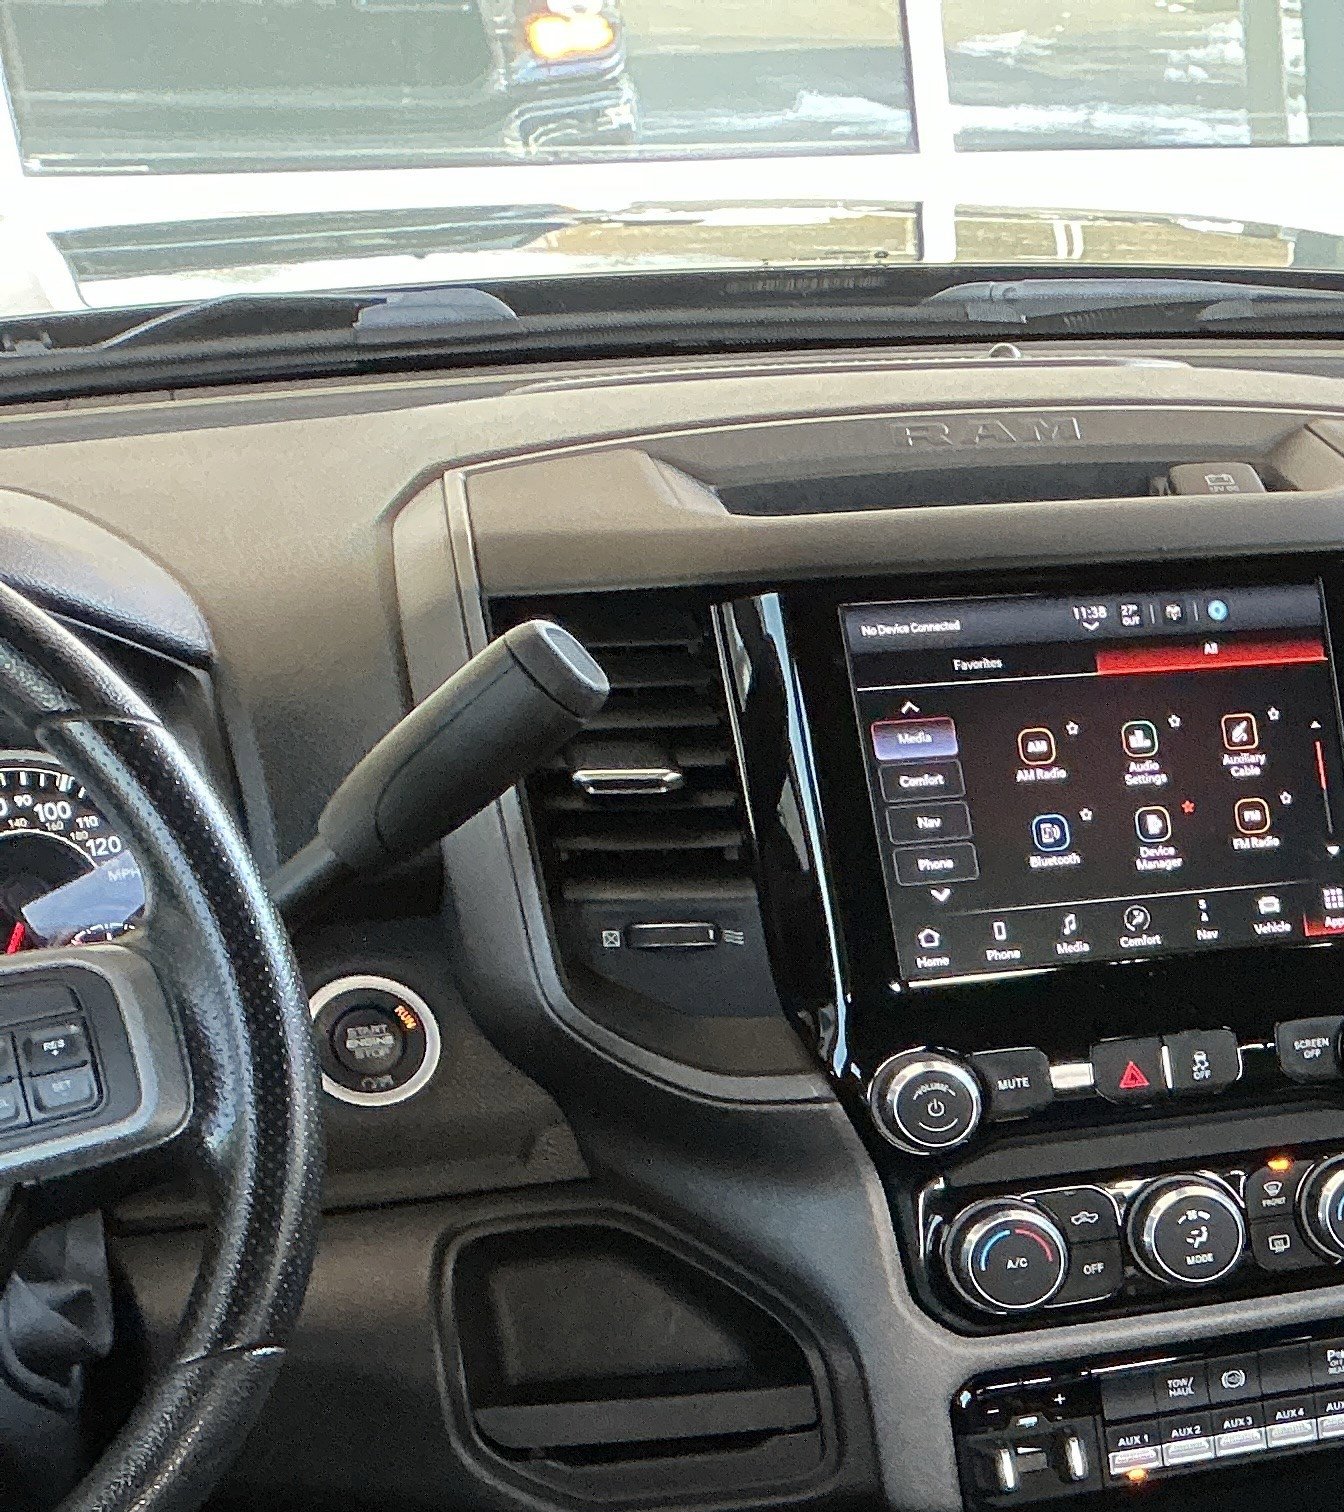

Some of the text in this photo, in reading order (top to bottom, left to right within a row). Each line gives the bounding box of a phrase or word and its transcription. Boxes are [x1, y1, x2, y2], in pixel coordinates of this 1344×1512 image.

[892, 416, 1081, 447] RAM
[1072, 605, 1107, 619] 11:38
[861, 619, 961, 636] No Device Connected
[953, 657, 1003, 671] Favorites
[897, 732, 932, 744] Media
[1223, 752, 1266, 766] Auxiliary
[1128, 761, 1160, 773] Audio
[1230, 765, 1261, 778] Cable
[899, 774, 945, 787] Comfort
[1016, 767, 1067, 782] AM Radio
[1124, 773, 1168, 787] Settings
[14, 794, 33, 808] 90
[33, 801, 72, 823] 100
[8, 817, 28, 829] 140
[76, 816, 99, 829] 110
[917, 816, 942, 829] Nav
[86, 836, 122, 857] 120
[1232, 836, 1281, 850] FM Radio
[1140, 846, 1176, 858] Device
[917, 858, 954, 871] Phone
[1029, 853, 1081, 868] Bluetooth
[1136, 857, 1183, 871] Manager
[1196, 929, 1219, 941] Nav
[1253, 922, 1292, 935] Vehicle
[1056, 941, 1090, 954] Media
[1119, 935, 1162, 948] Comfort
[986, 949, 1021, 961] Phone
[916, 956, 950, 969] Home
[394, 1005, 416, 1029] RUN
[1294, 1038, 1329, 1050] SCREEN
[1303, 1047, 1321, 1059] OFF
[1193, 1069, 1211, 1080] OFF
[998, 1077, 1030, 1090] MUTE
[1006, 1258, 1028, 1269] A/C
[1186, 1253, 1213, 1265] MODE
[1083, 1262, 1104, 1275] OFF
[1168, 1385, 1194, 1397] HAUL
